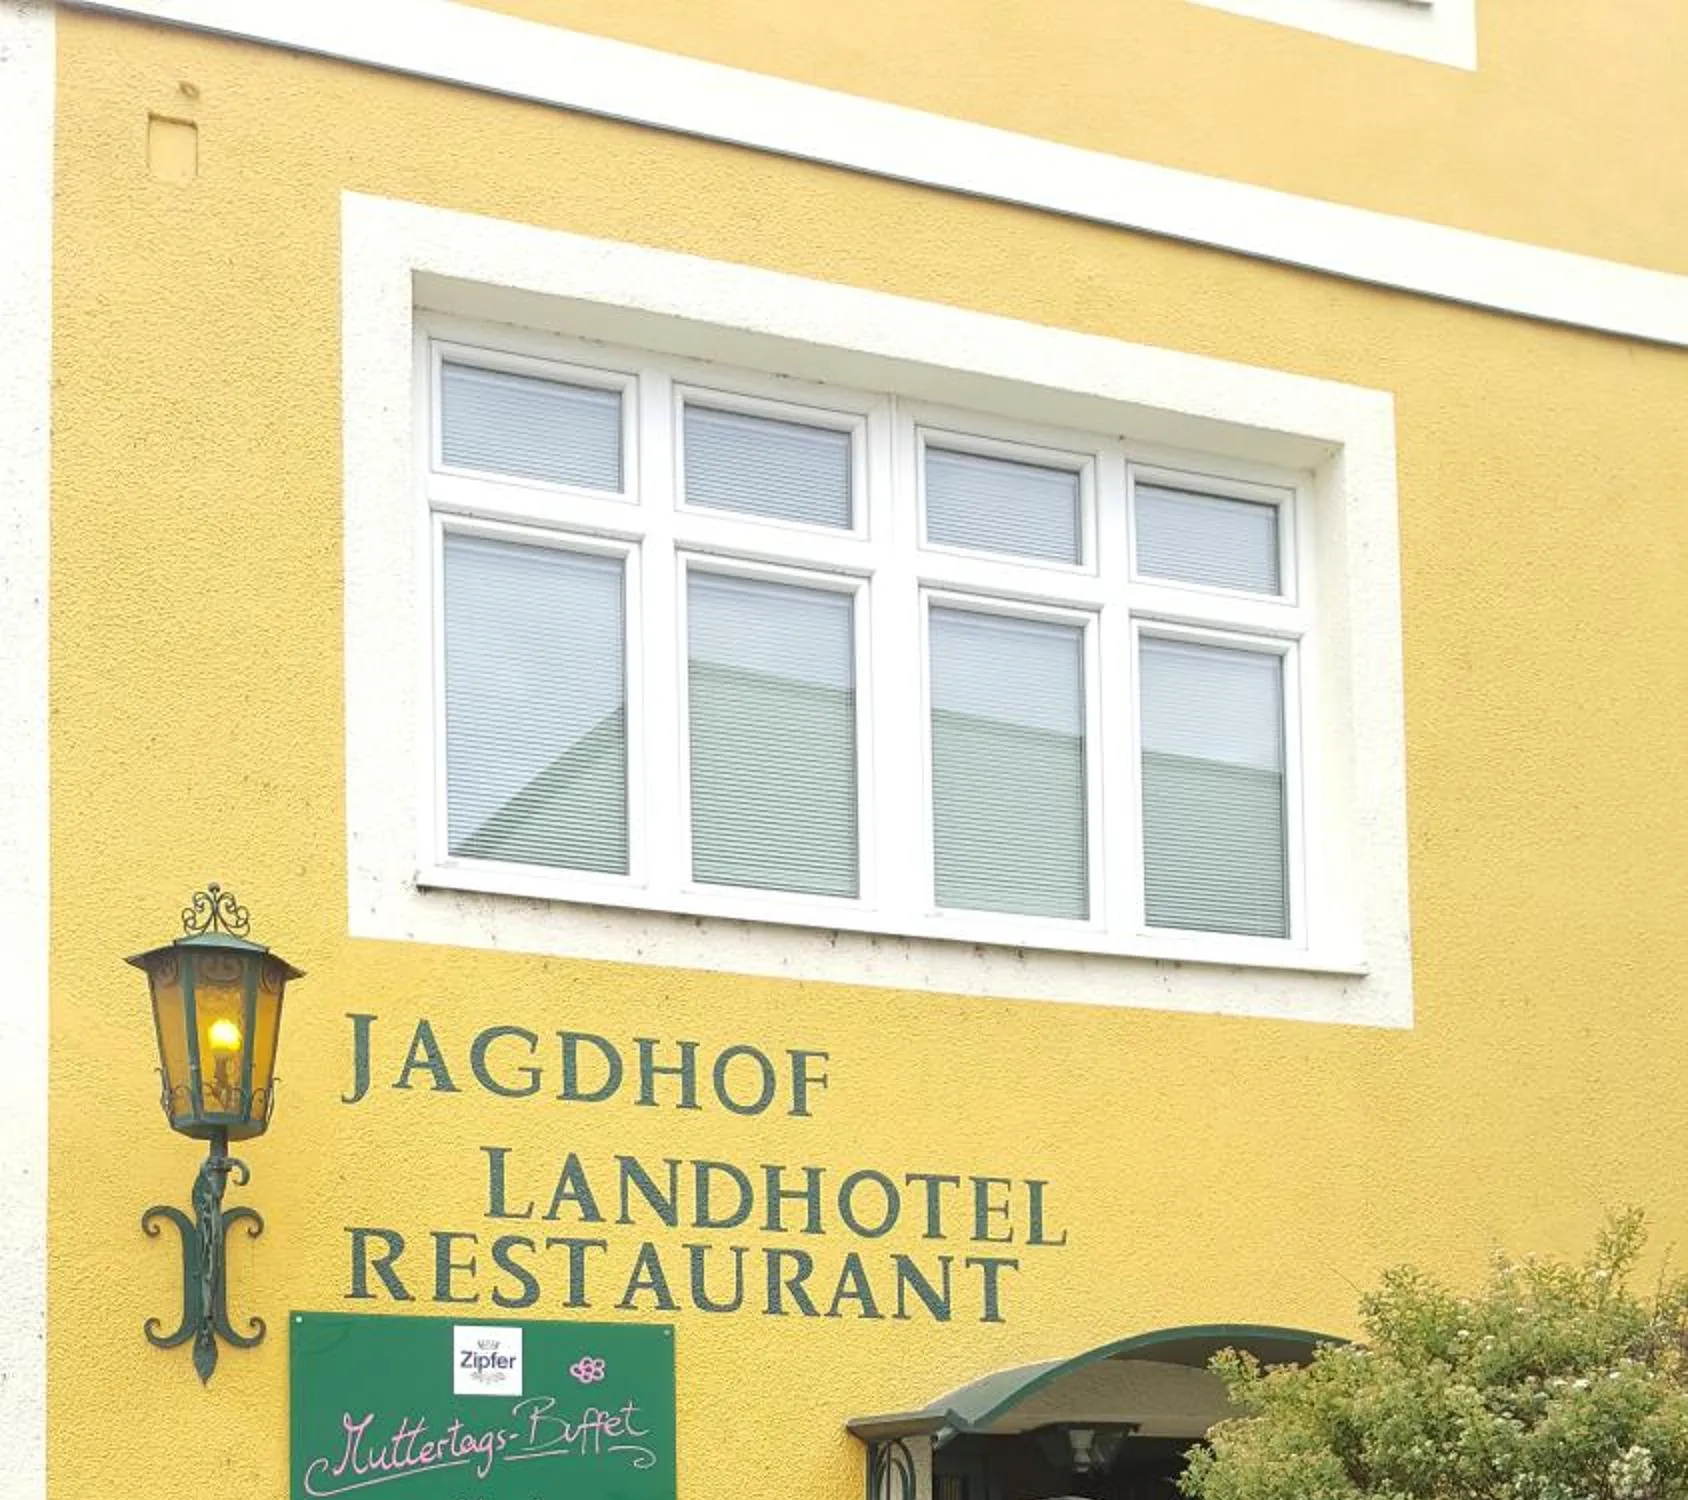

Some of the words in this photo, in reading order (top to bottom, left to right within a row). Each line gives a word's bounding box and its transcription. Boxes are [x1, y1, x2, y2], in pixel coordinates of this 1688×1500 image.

[340, 1012, 830, 1118] JAGDHOF
[480, 1145, 1068, 1247] LANDHOTEL
[343, 1225, 1020, 1323] RESTAURANT
[460, 1350, 517, 1374] Zipfer
